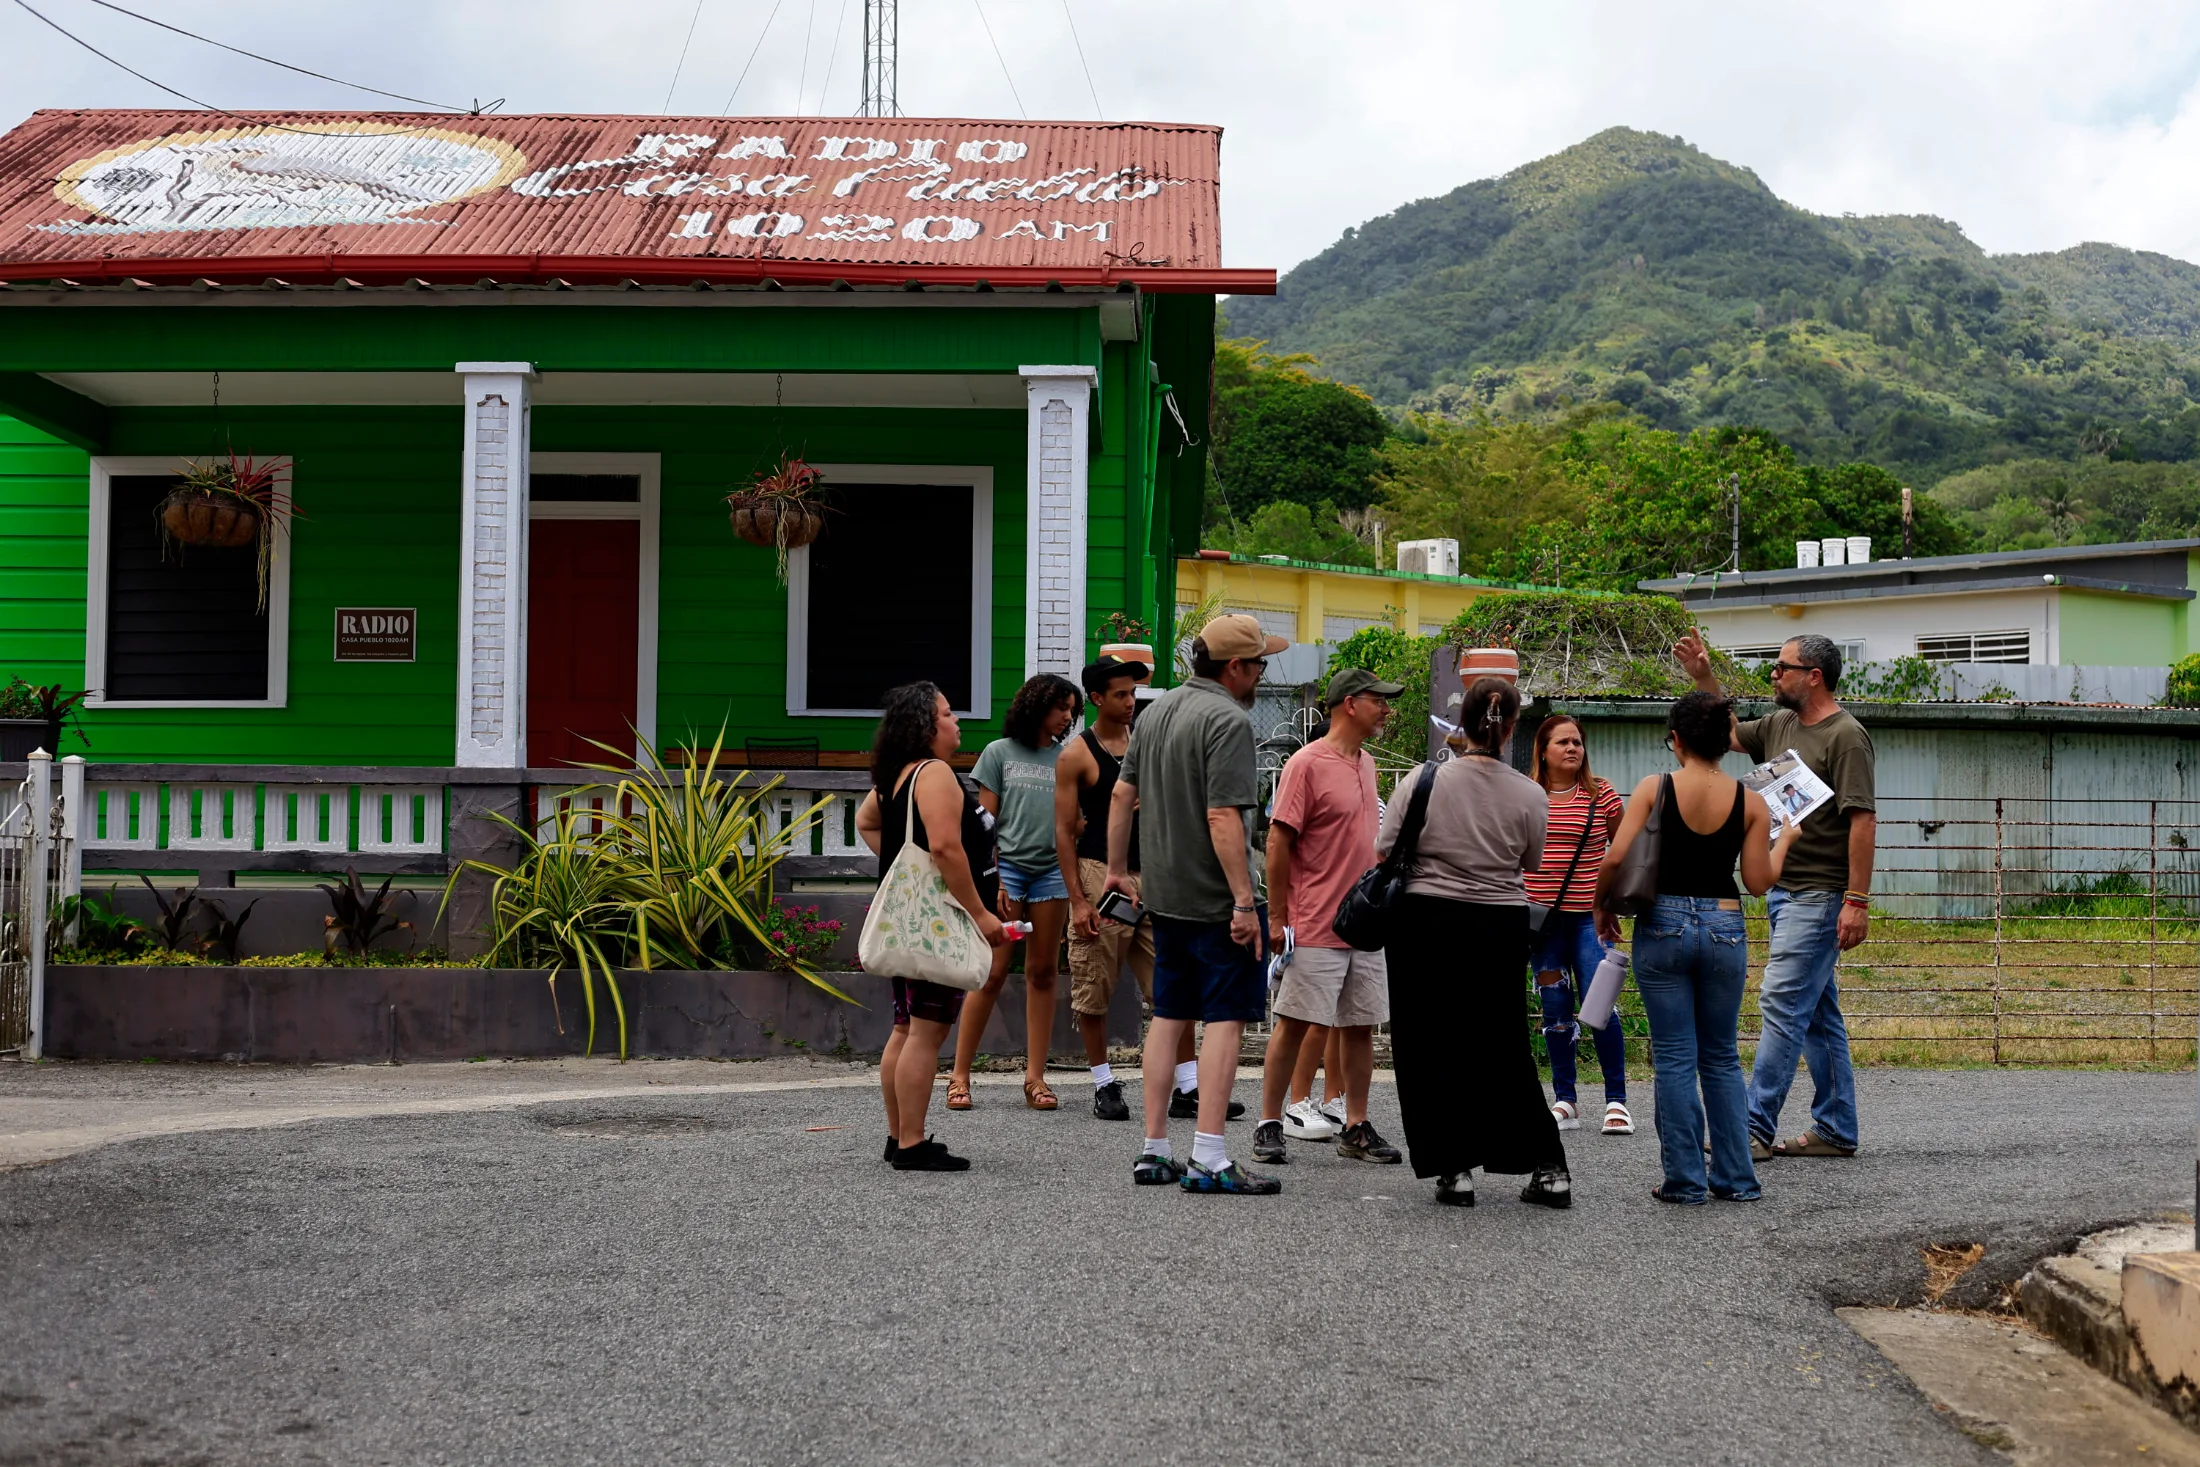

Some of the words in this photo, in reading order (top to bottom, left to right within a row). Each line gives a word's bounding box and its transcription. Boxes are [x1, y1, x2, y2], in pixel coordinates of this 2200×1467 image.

[626, 133, 1028, 164] RADIO
[511, 155, 816, 198] Casa
[669, 210, 982, 243] 1020
[992, 218, 1116, 243] AM
[342, 615, 409, 635] RADIO
